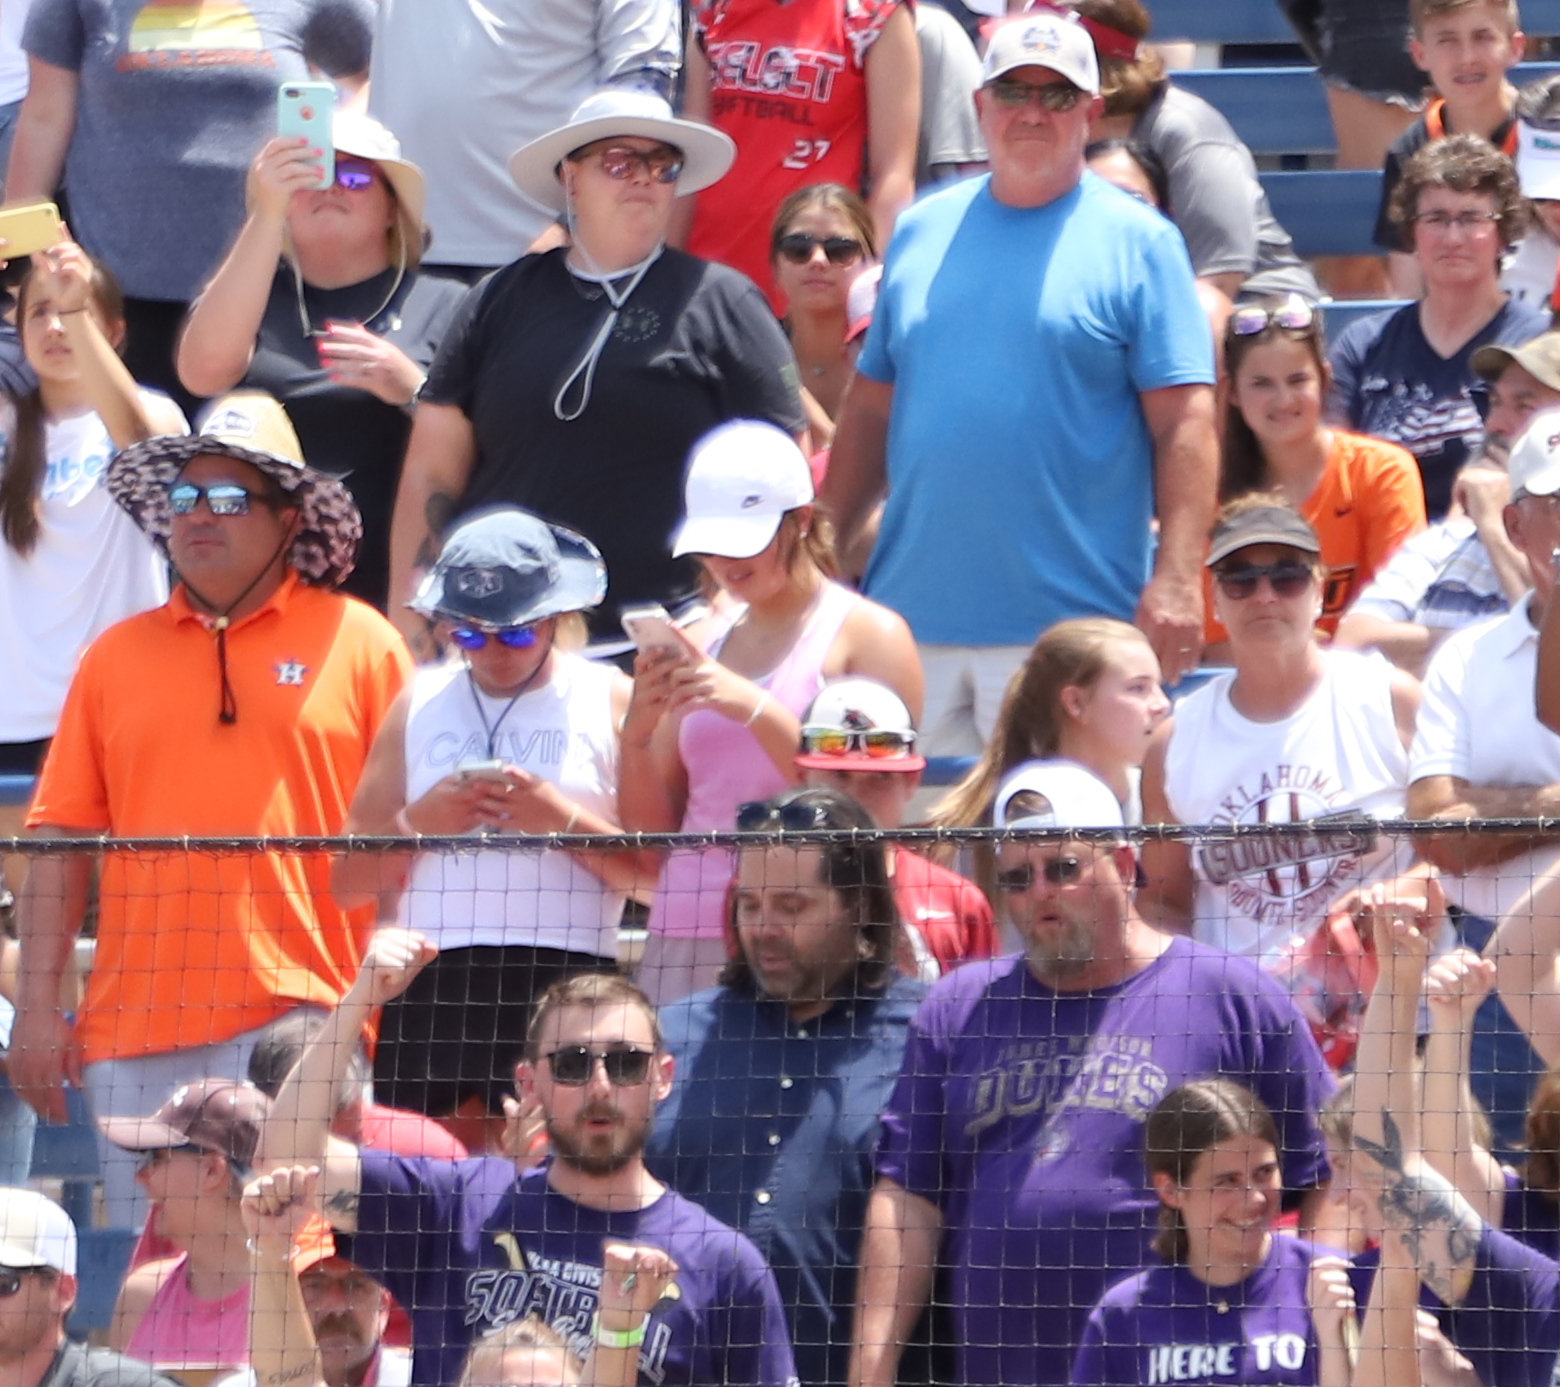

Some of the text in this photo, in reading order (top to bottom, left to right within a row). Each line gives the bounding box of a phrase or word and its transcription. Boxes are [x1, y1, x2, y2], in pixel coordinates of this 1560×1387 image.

[782, 138, 833, 169] 27
[962, 1054, 1172, 1136] DUKES
[1149, 1332, 1308, 1384] HERE TO
